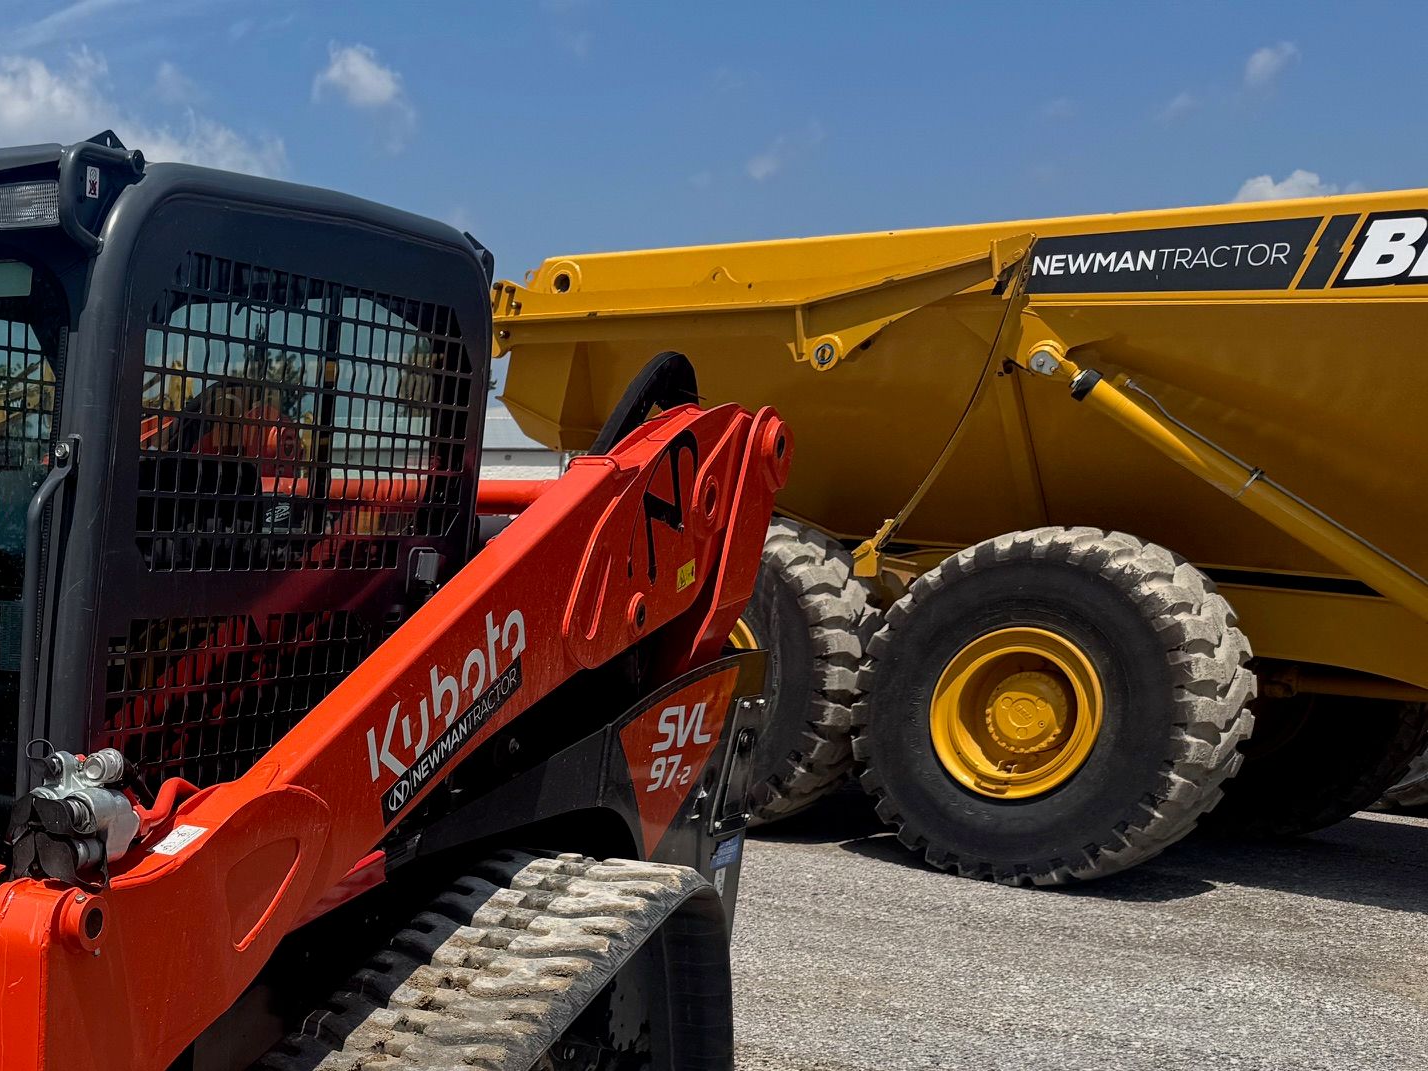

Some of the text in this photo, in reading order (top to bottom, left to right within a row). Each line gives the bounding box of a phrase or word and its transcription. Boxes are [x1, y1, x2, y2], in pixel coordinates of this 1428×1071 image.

[366, 609, 526, 783] Kubota
[651, 702, 712, 753] SVL
[645, 753, 692, 792] 97-2
